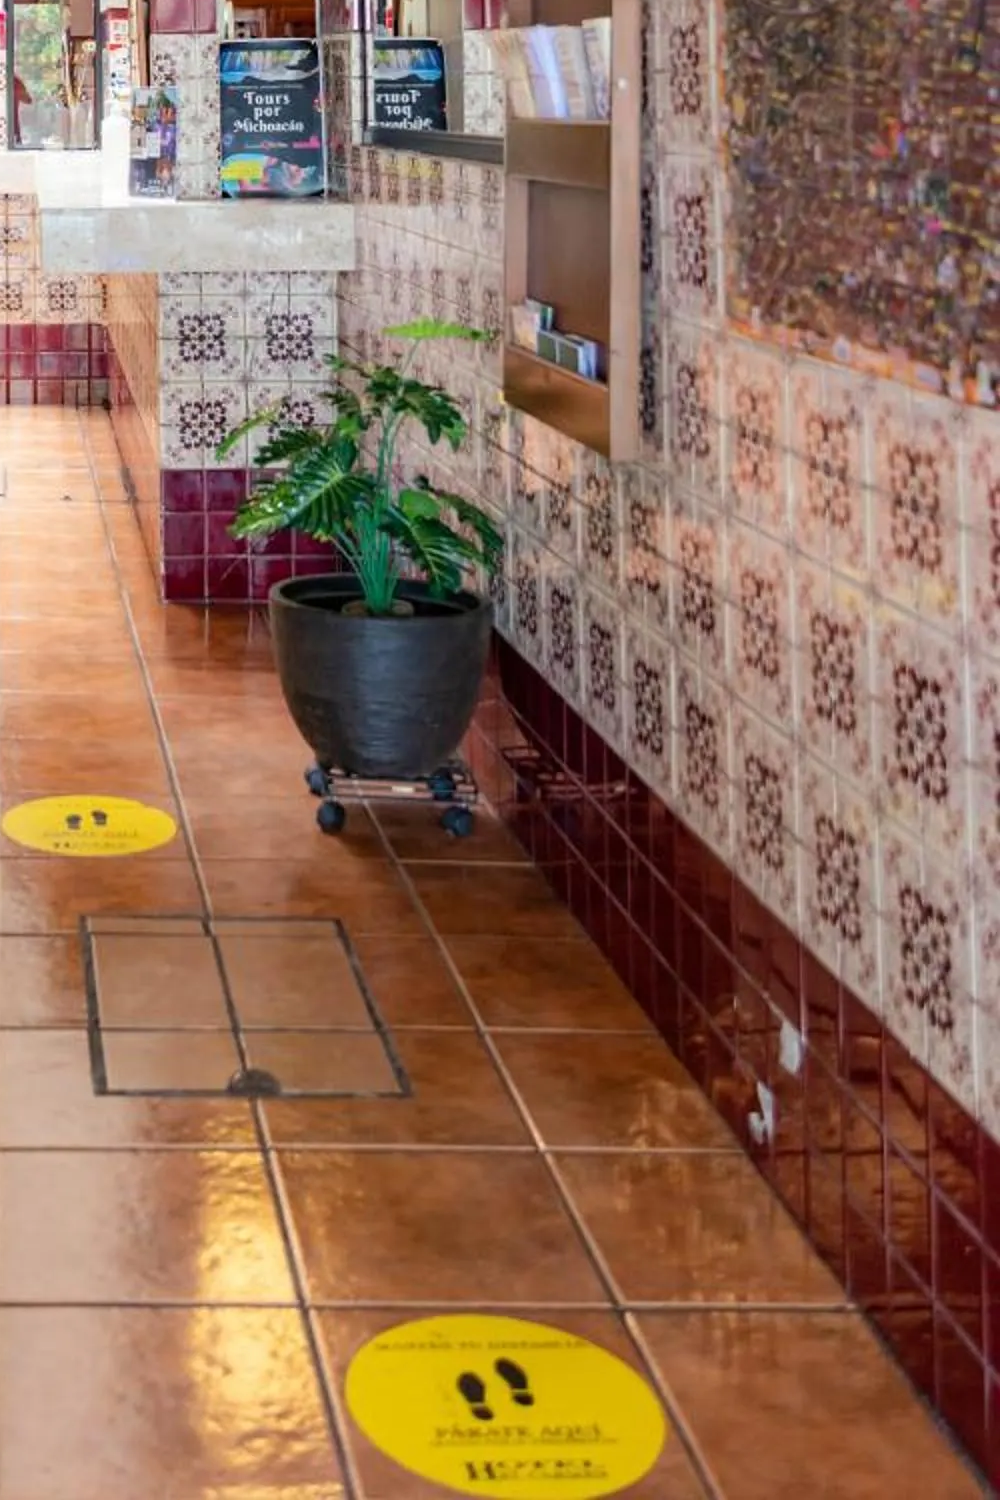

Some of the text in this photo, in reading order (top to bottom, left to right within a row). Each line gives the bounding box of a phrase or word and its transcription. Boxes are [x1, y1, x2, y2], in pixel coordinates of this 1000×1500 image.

[243, 91, 291, 105] Tours
[254, 106, 281, 120] por
[233, 118, 305, 133] Michoacán
